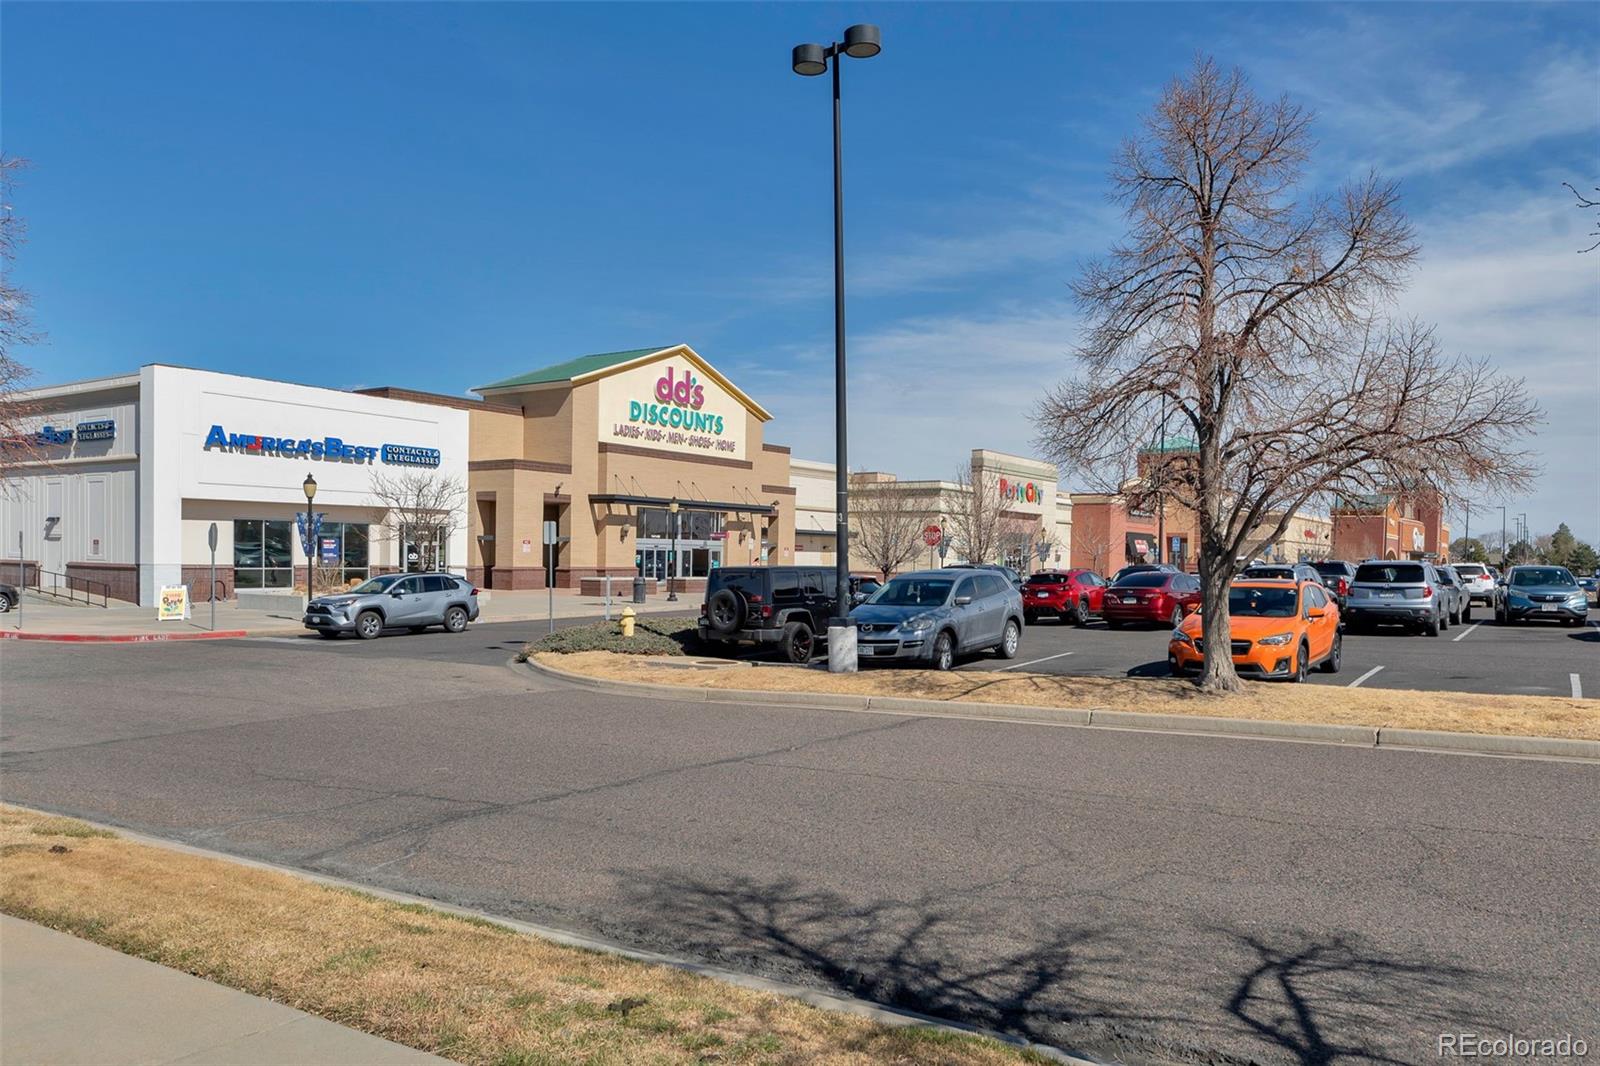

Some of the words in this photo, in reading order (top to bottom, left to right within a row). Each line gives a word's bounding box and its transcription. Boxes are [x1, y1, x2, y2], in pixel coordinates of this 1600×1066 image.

[655, 366, 704, 410] dd's
[629, 400, 724, 435] DISCOUNTS
[77, 422, 105, 431] ONTACTS
[77, 430, 113, 440] YEGLASSES
[613, 423, 641, 440] LADIES
[644, 428, 663, 442] KIDS
[667, 431, 685, 446] MEN
[688, 435, 711, 450] SHOES
[715, 439, 736, 452] HOME
[386, 446, 431, 457] CONTACTS
[387, 453, 439, 465] EYEGLASSES
[924, 531, 941, 541] STOP
